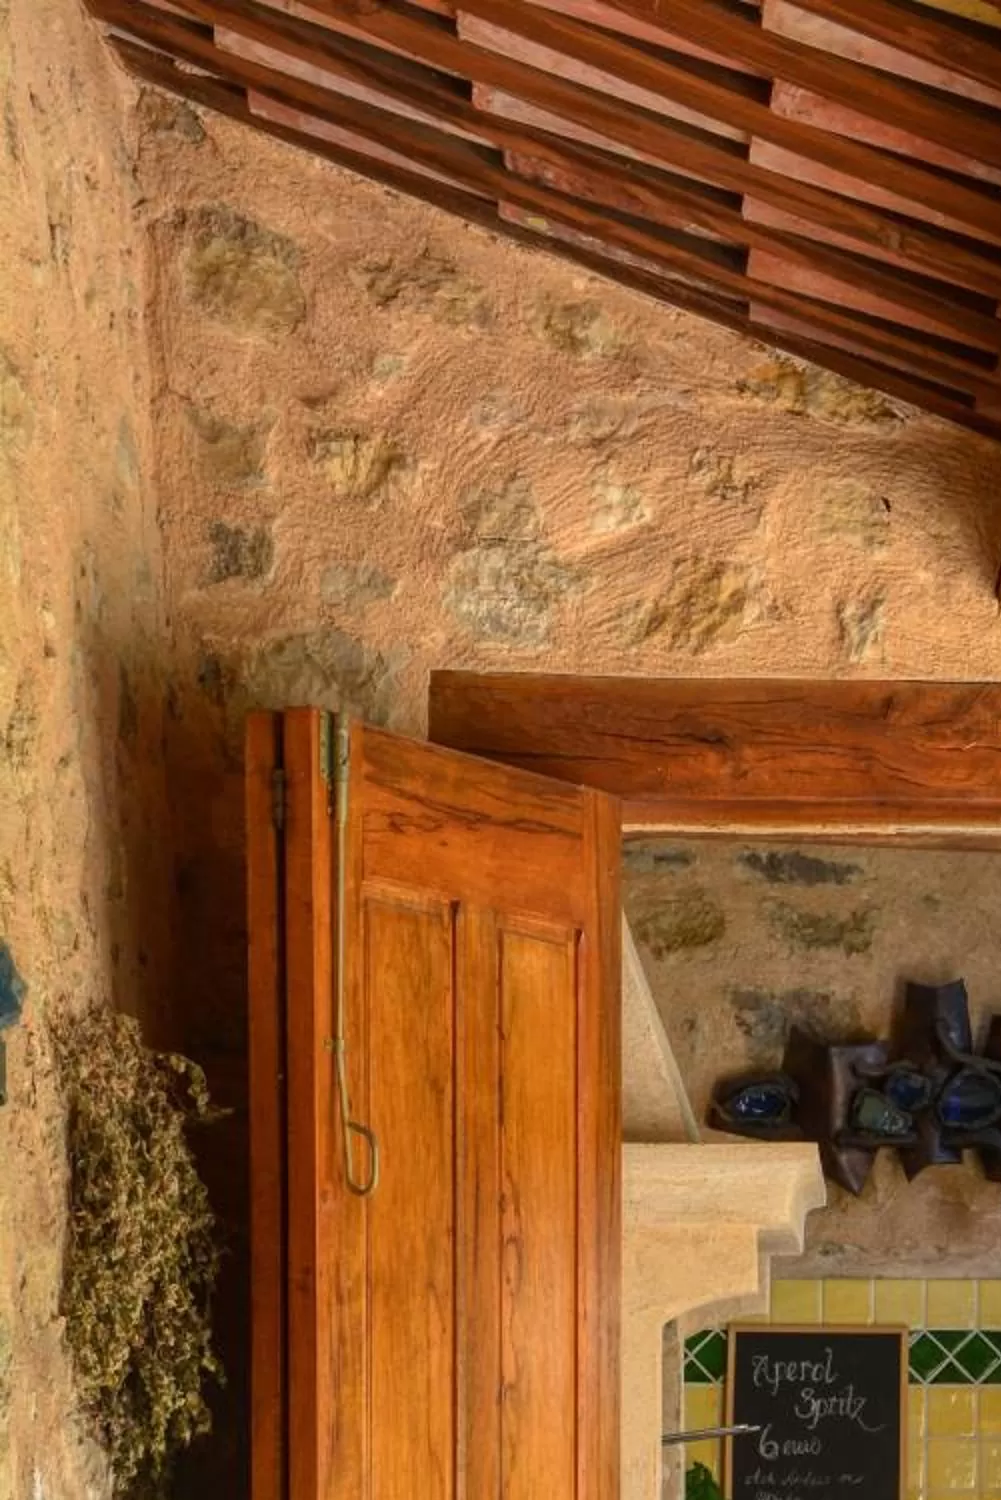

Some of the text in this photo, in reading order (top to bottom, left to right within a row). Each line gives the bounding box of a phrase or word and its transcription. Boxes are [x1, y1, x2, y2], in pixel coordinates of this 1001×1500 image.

[751, 1347, 840, 1397] Aperol
[794, 1384, 886, 1433] Spritz
[758, 1423, 780, 1461] 6
